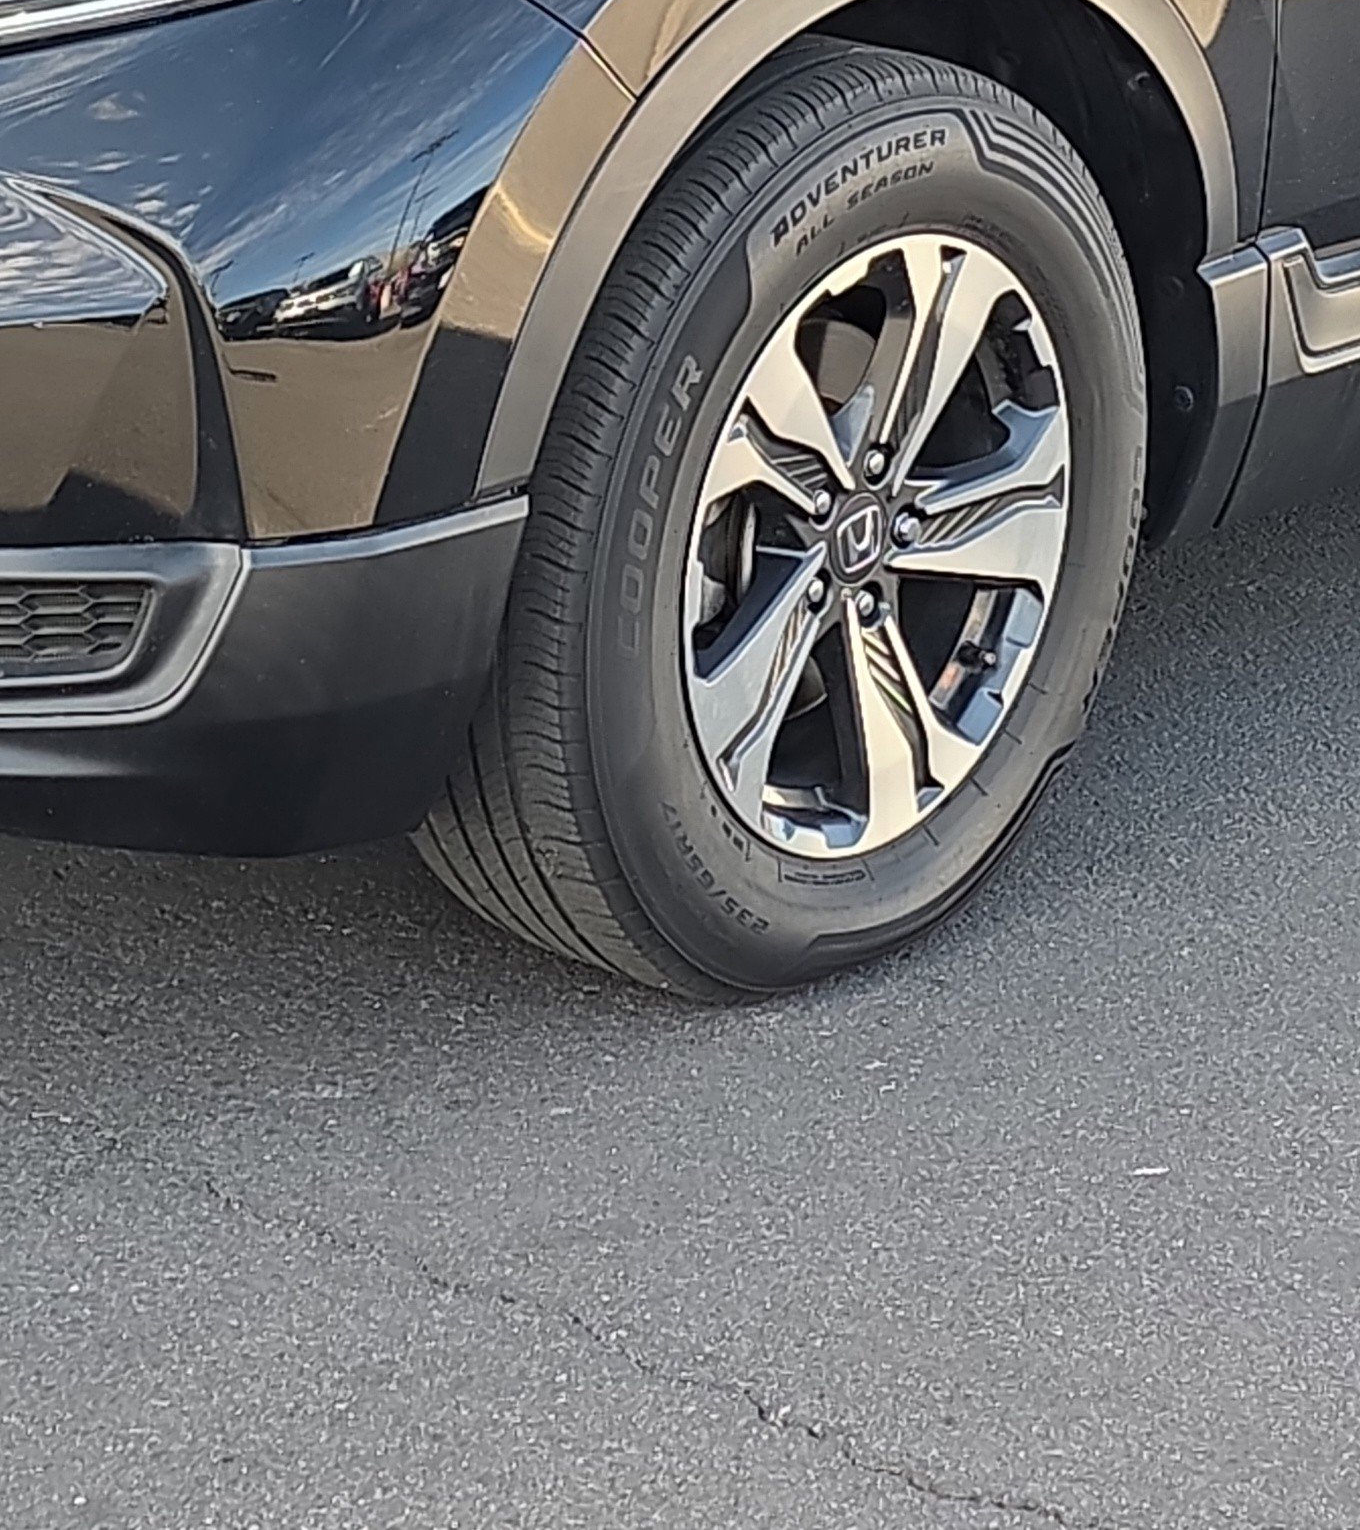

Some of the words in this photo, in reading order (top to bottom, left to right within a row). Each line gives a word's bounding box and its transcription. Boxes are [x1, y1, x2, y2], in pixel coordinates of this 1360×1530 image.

[770, 129, 946, 247] ADVENTURER
[797, 214, 835, 256] ALL
[846, 161, 934, 210] SEASON
[617, 354, 703, 659] COOPER
